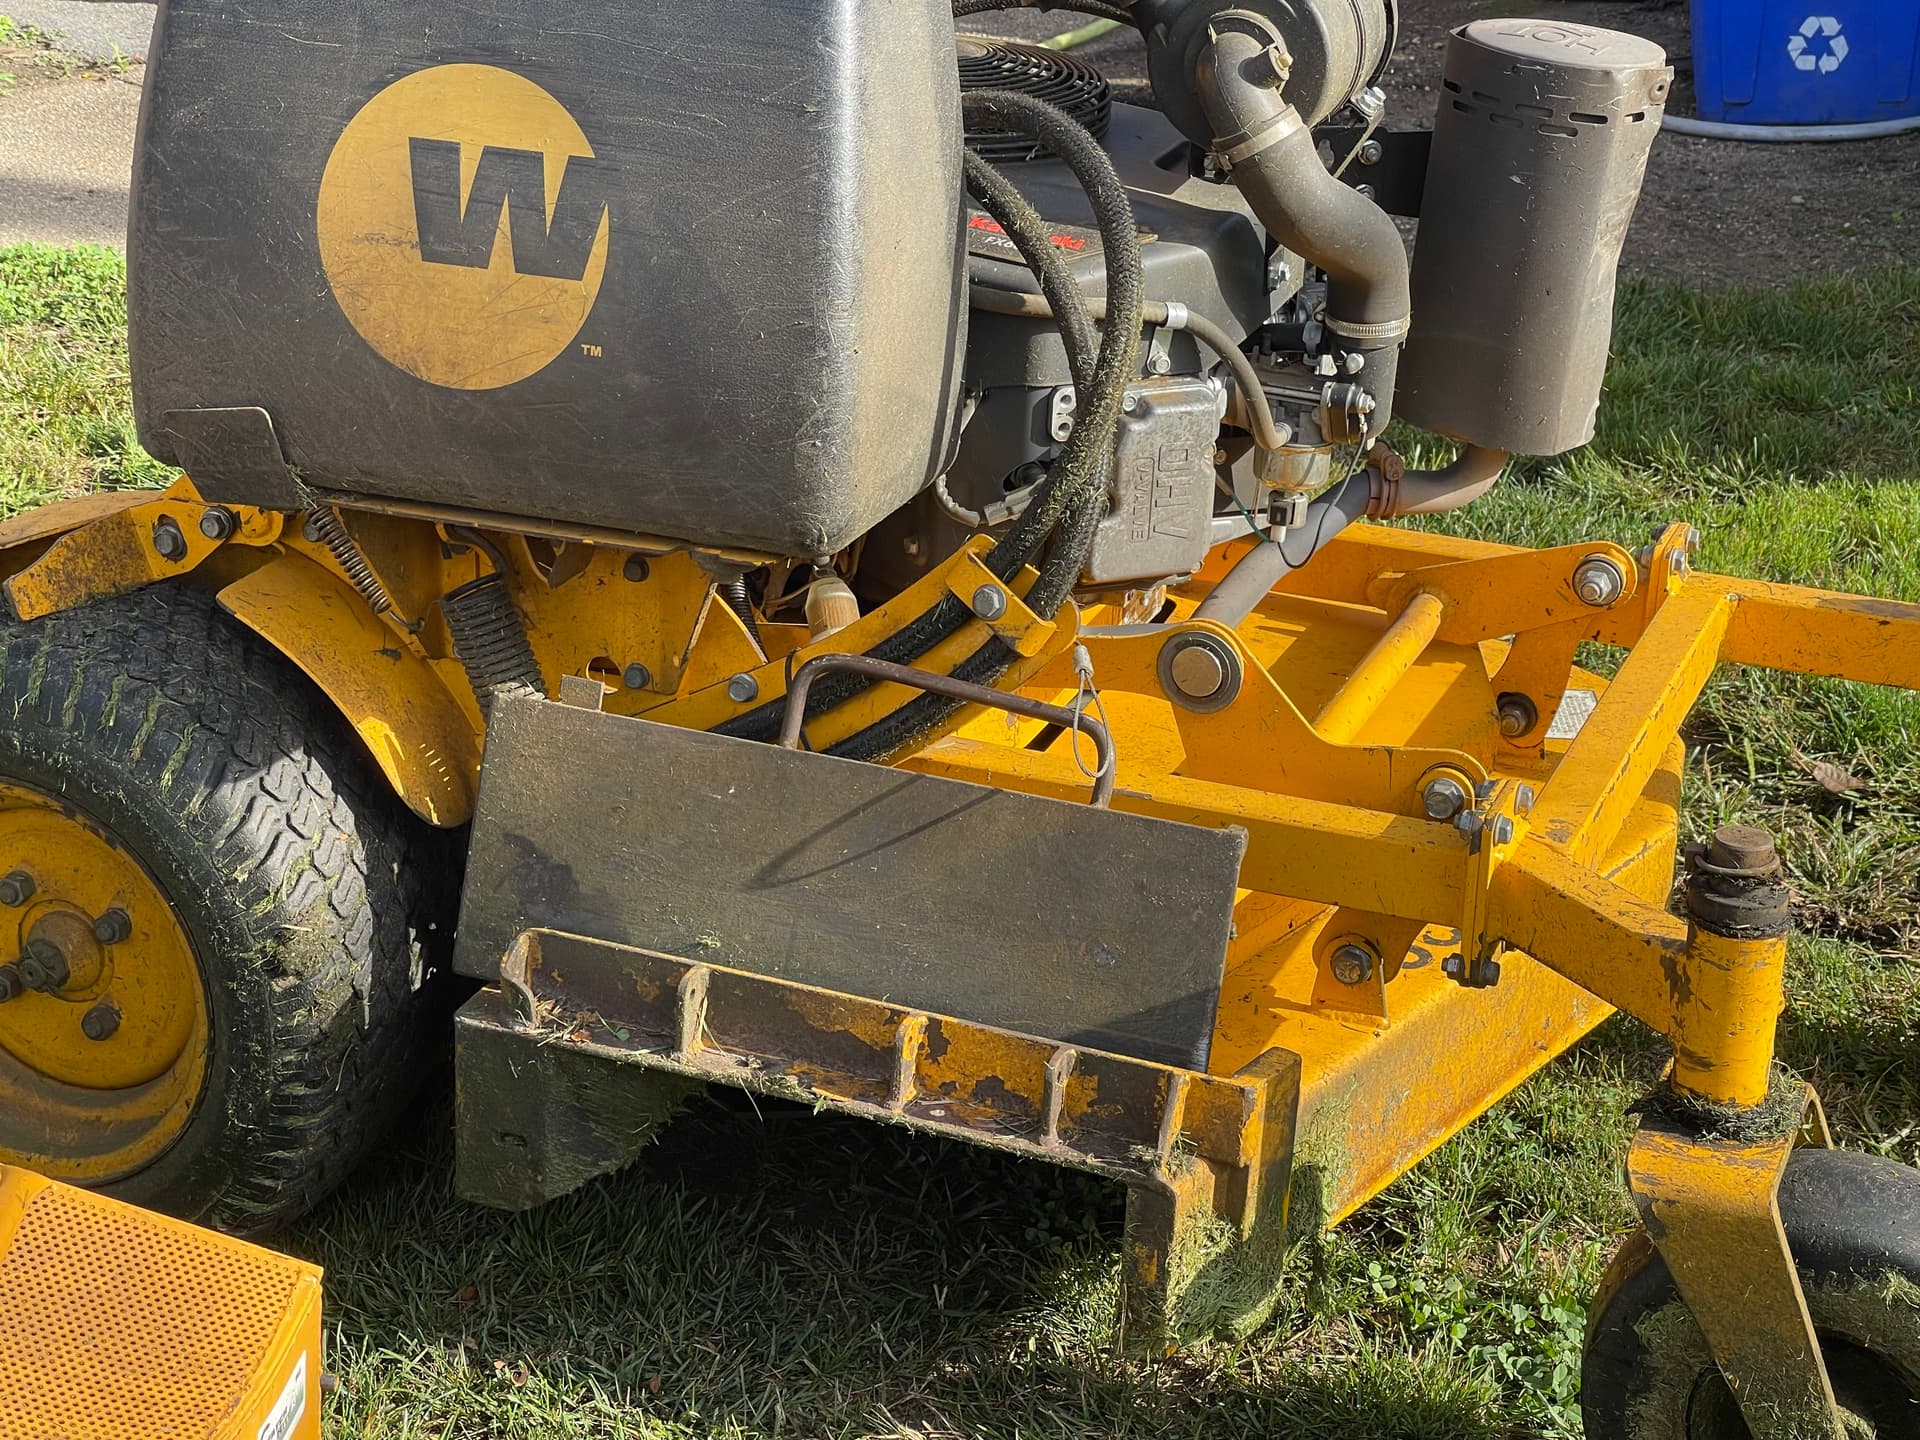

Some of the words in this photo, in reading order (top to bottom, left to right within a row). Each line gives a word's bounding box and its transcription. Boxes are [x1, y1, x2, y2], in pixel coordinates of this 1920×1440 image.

[1496, 25, 1611, 57] HOT
[408, 136, 608, 282] W
[581, 343, 602, 358] TM
